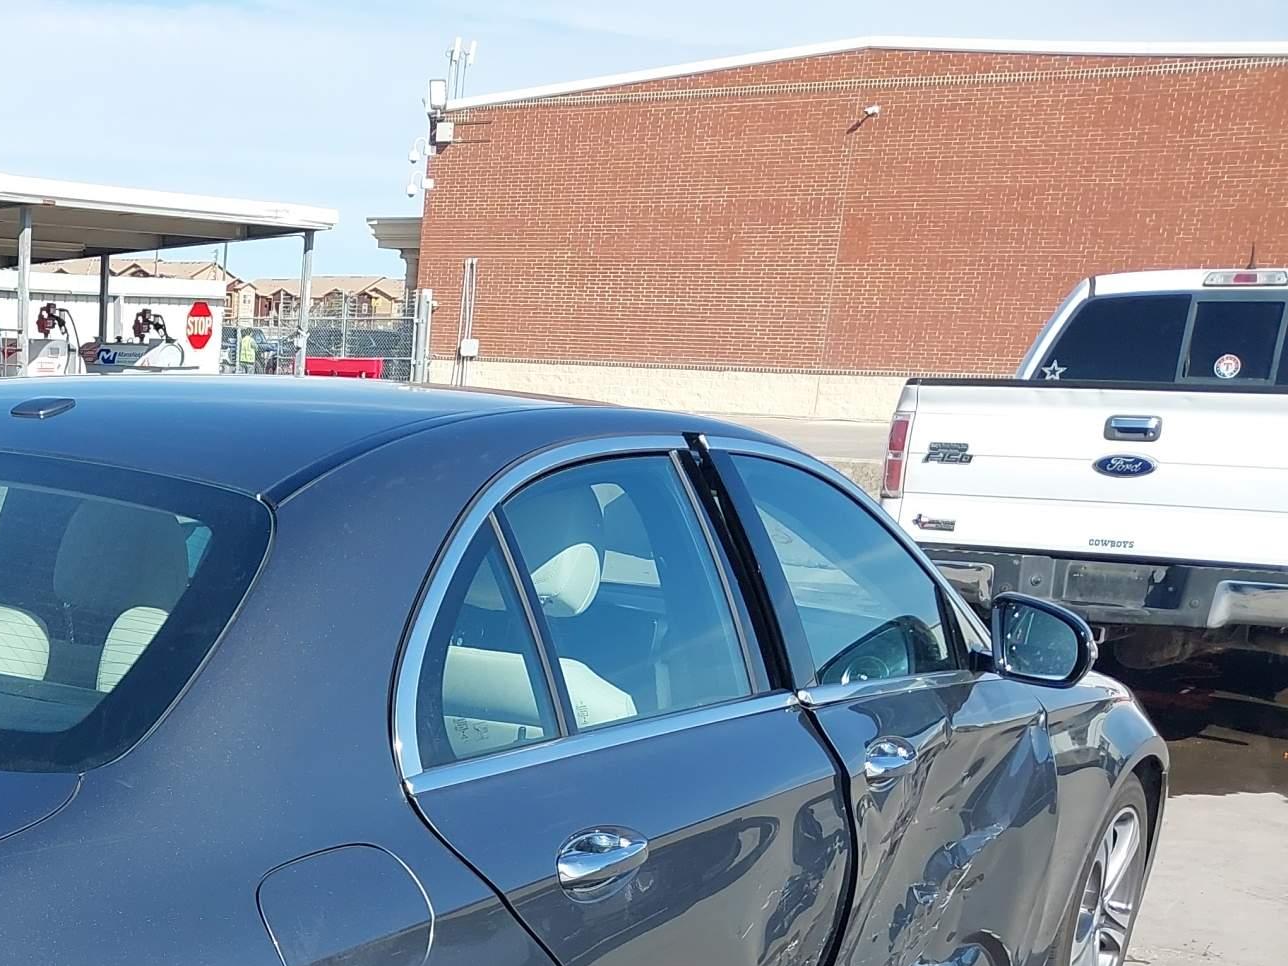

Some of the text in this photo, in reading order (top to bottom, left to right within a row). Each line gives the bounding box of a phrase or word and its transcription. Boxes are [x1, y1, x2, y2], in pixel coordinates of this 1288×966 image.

[187, 317, 212, 336] STOP
[1106, 457, 1143, 473] Ford
[1088, 538, 1135, 549] COWBOYS
